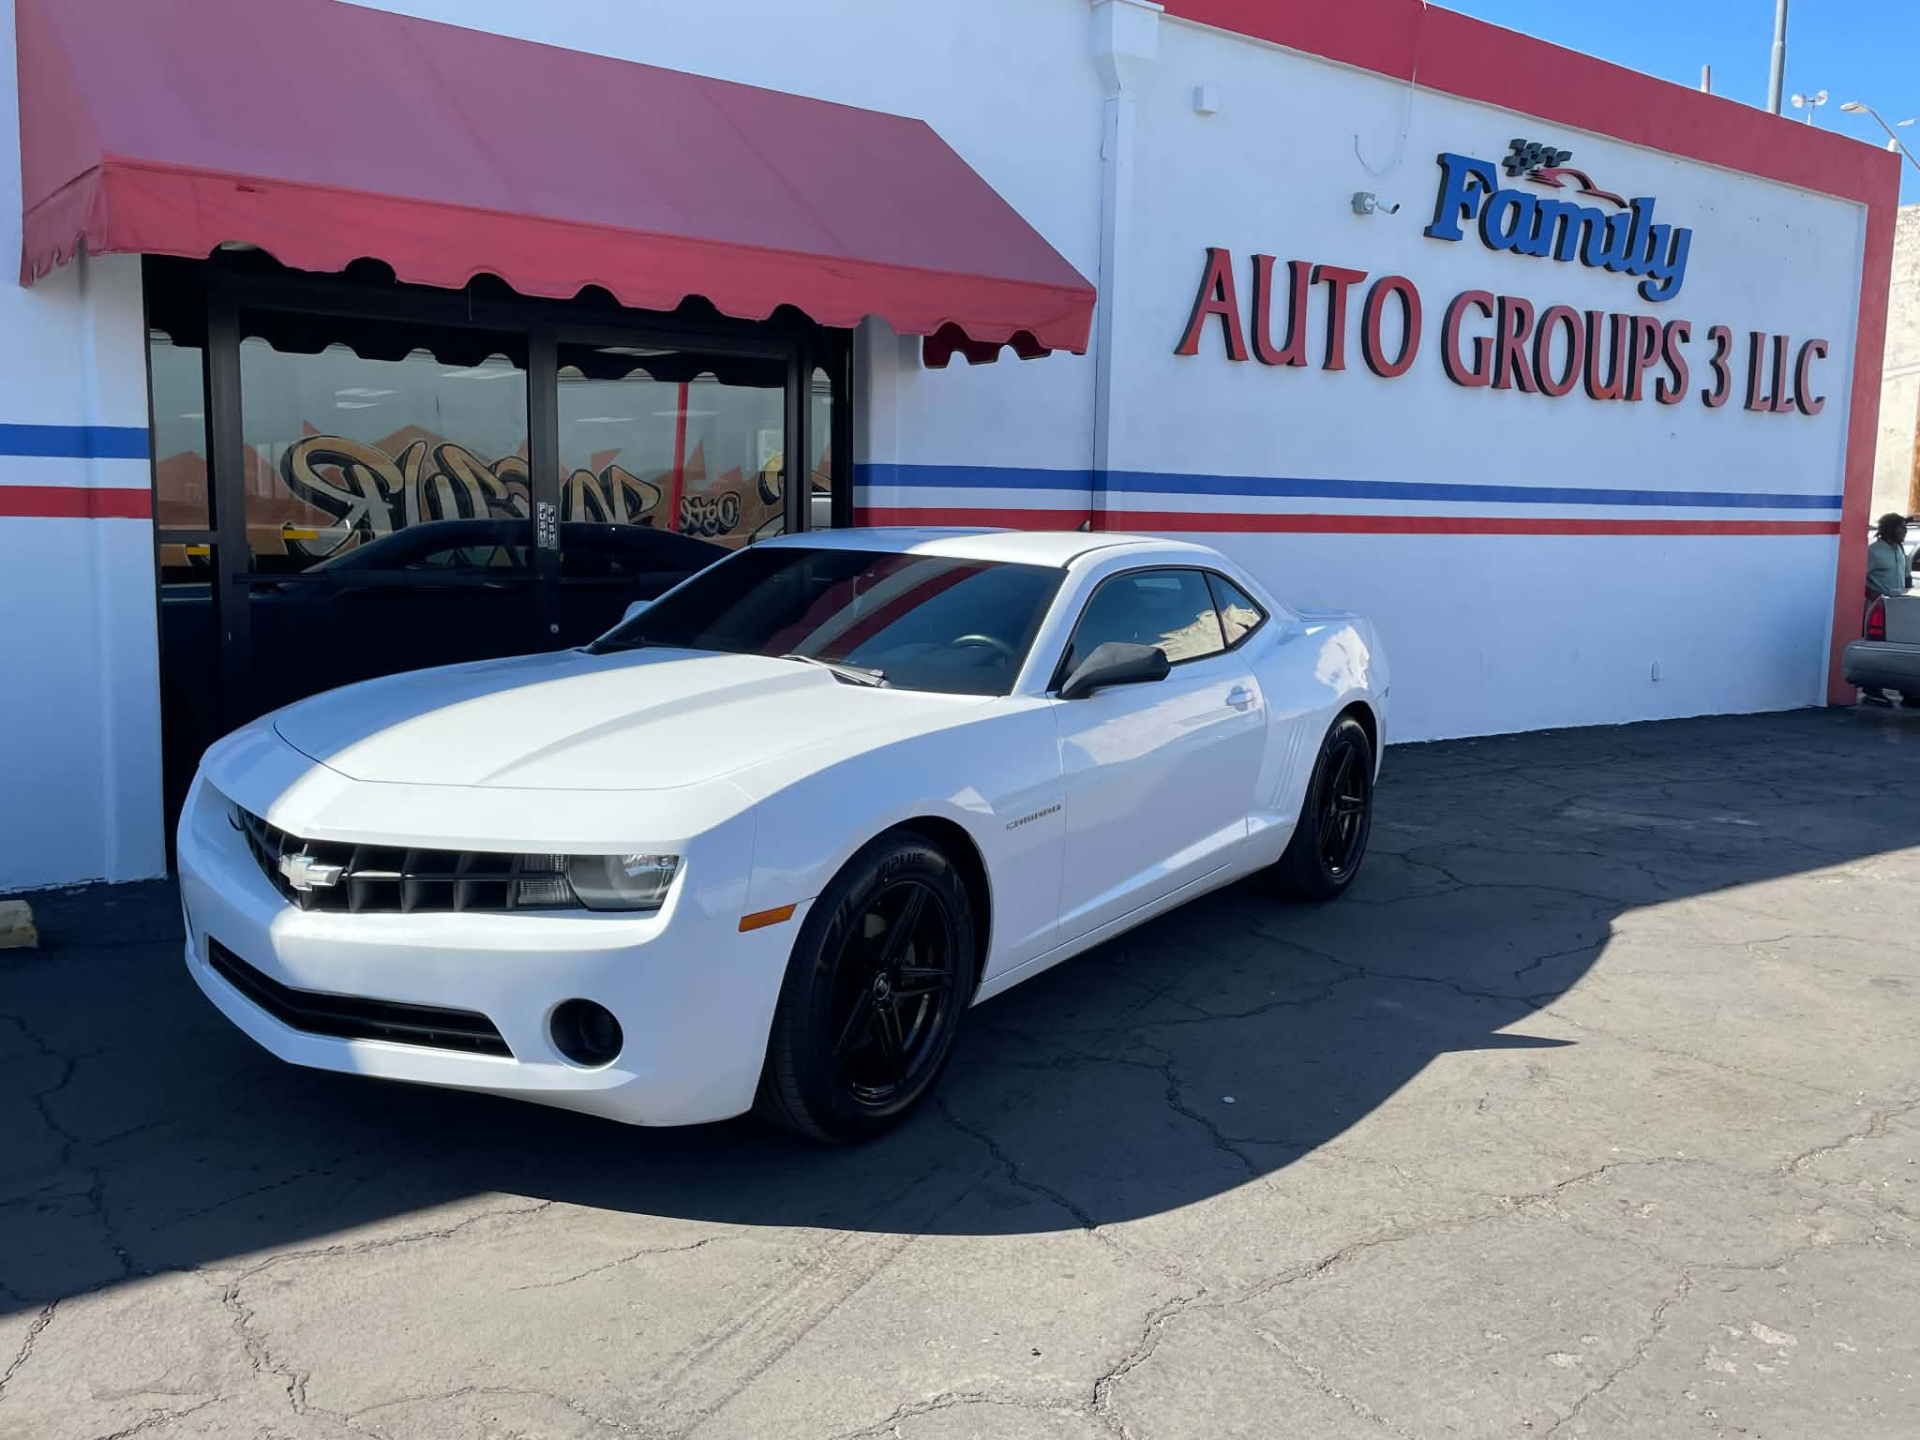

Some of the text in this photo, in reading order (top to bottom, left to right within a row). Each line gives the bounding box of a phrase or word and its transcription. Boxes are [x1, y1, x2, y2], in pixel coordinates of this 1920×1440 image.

[1424, 153, 1692, 302] Family
[1174, 247, 1829, 416] AUTO GROUPS 3 LLC
